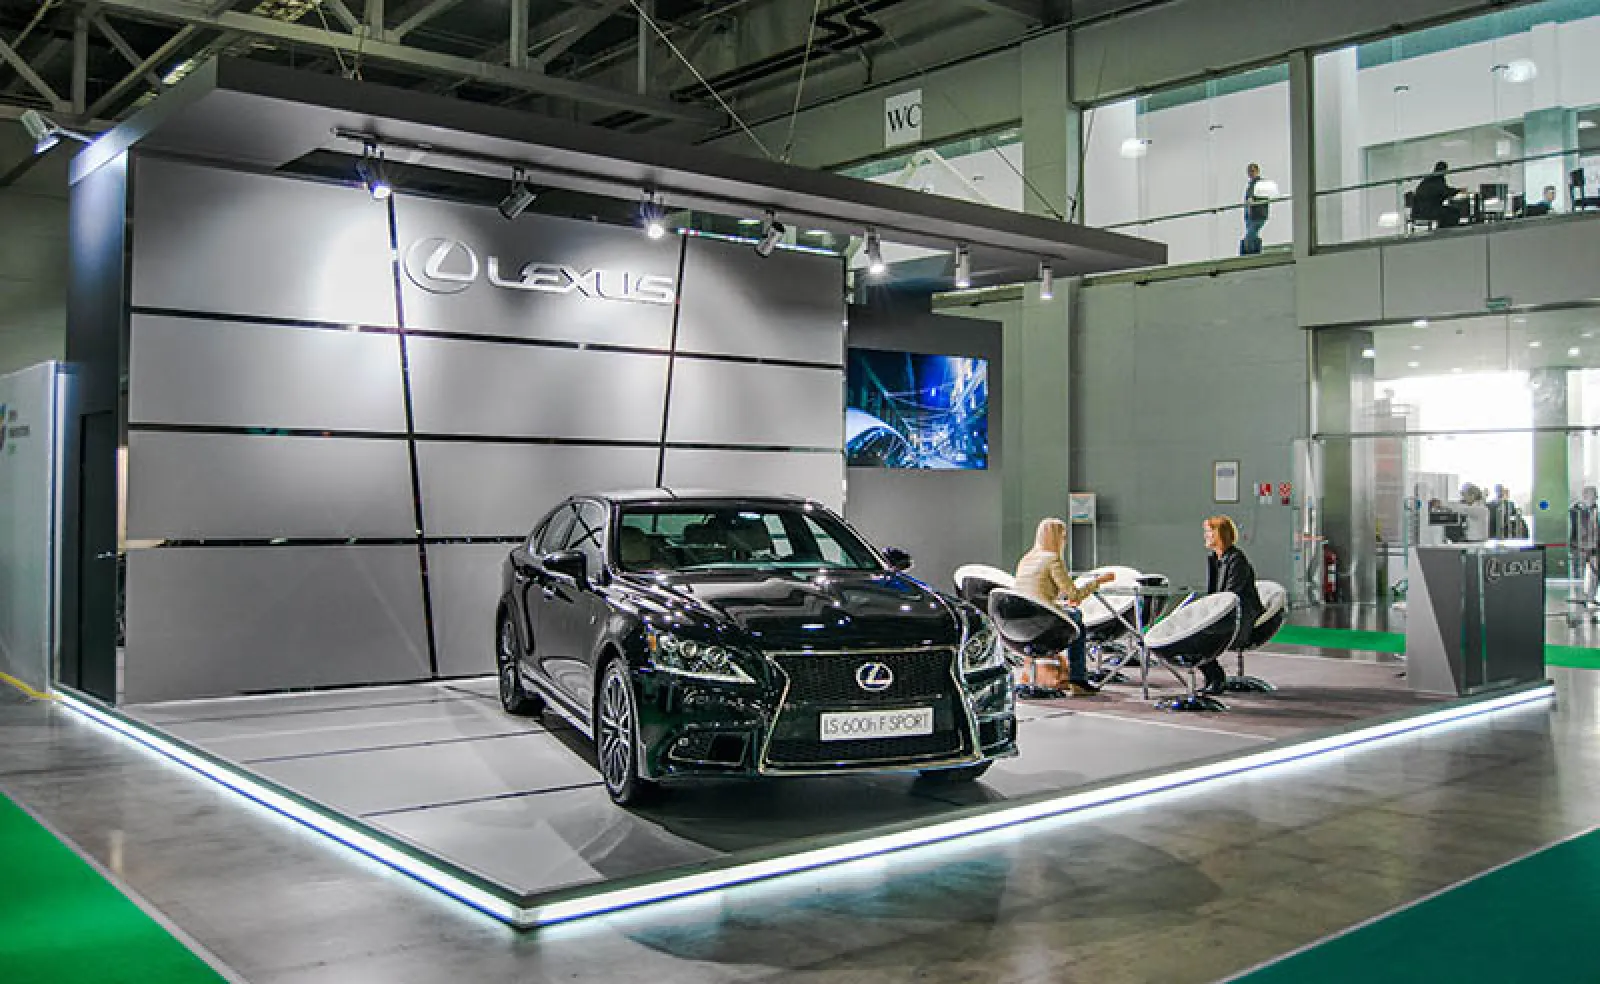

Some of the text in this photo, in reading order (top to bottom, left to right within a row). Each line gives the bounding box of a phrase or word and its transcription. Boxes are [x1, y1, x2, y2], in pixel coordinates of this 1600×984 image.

[887, 103, 922, 132] WC
[487, 255, 675, 305] LEXUS
[823, 717, 839, 735] LS
[879, 715, 886, 731] F
[888, 713, 929, 733] SPORT
